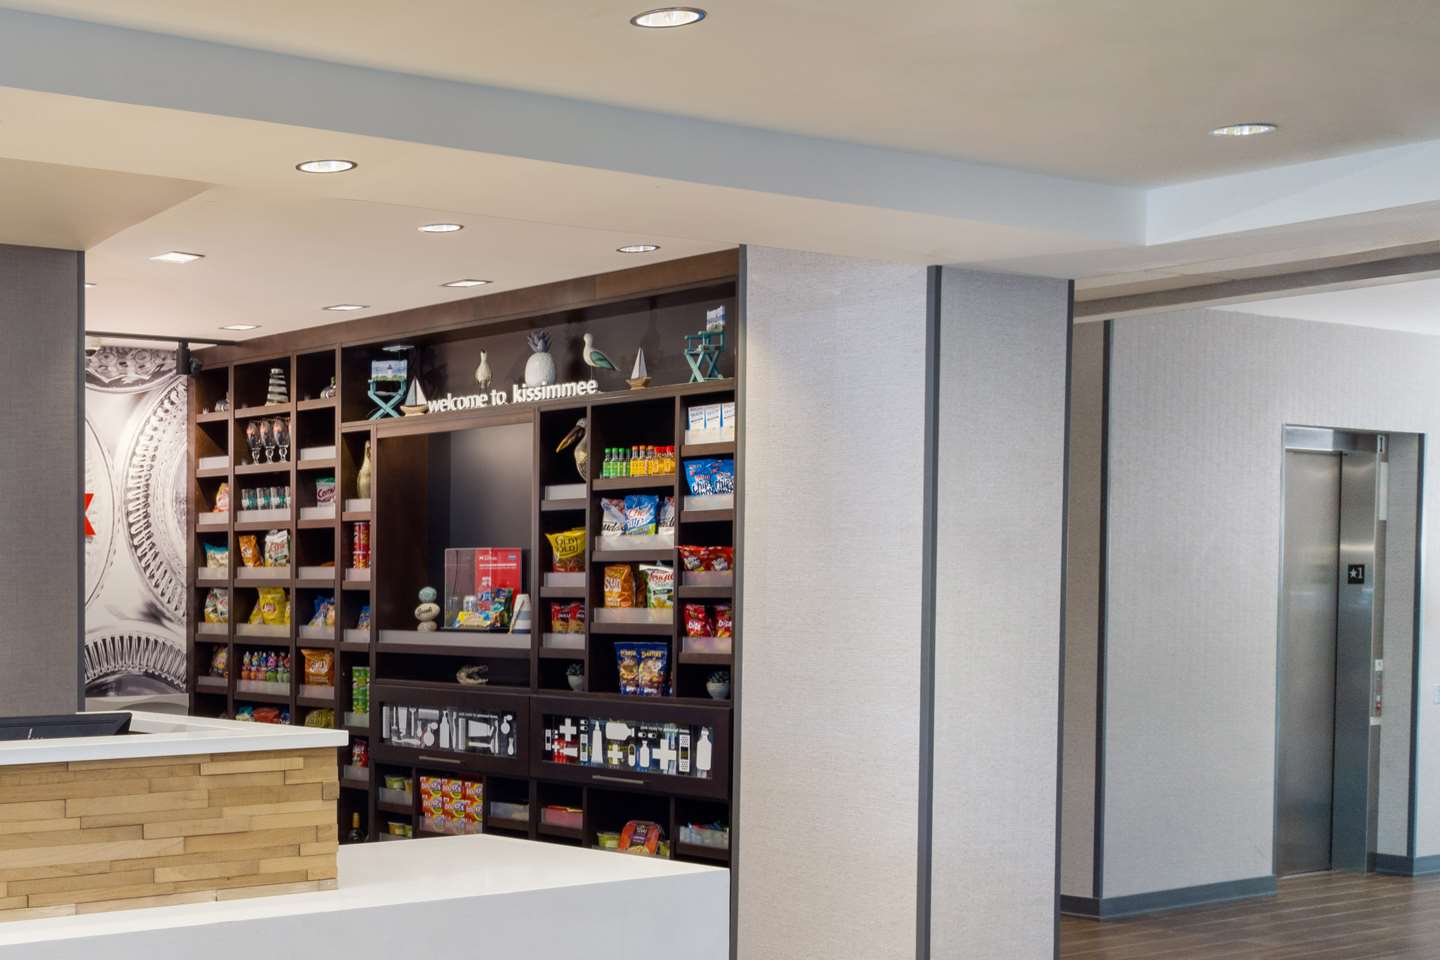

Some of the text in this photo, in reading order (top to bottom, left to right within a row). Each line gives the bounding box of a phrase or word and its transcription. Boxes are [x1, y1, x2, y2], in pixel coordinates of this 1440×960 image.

[428, 379, 600, 414] welcome to kissimmee
